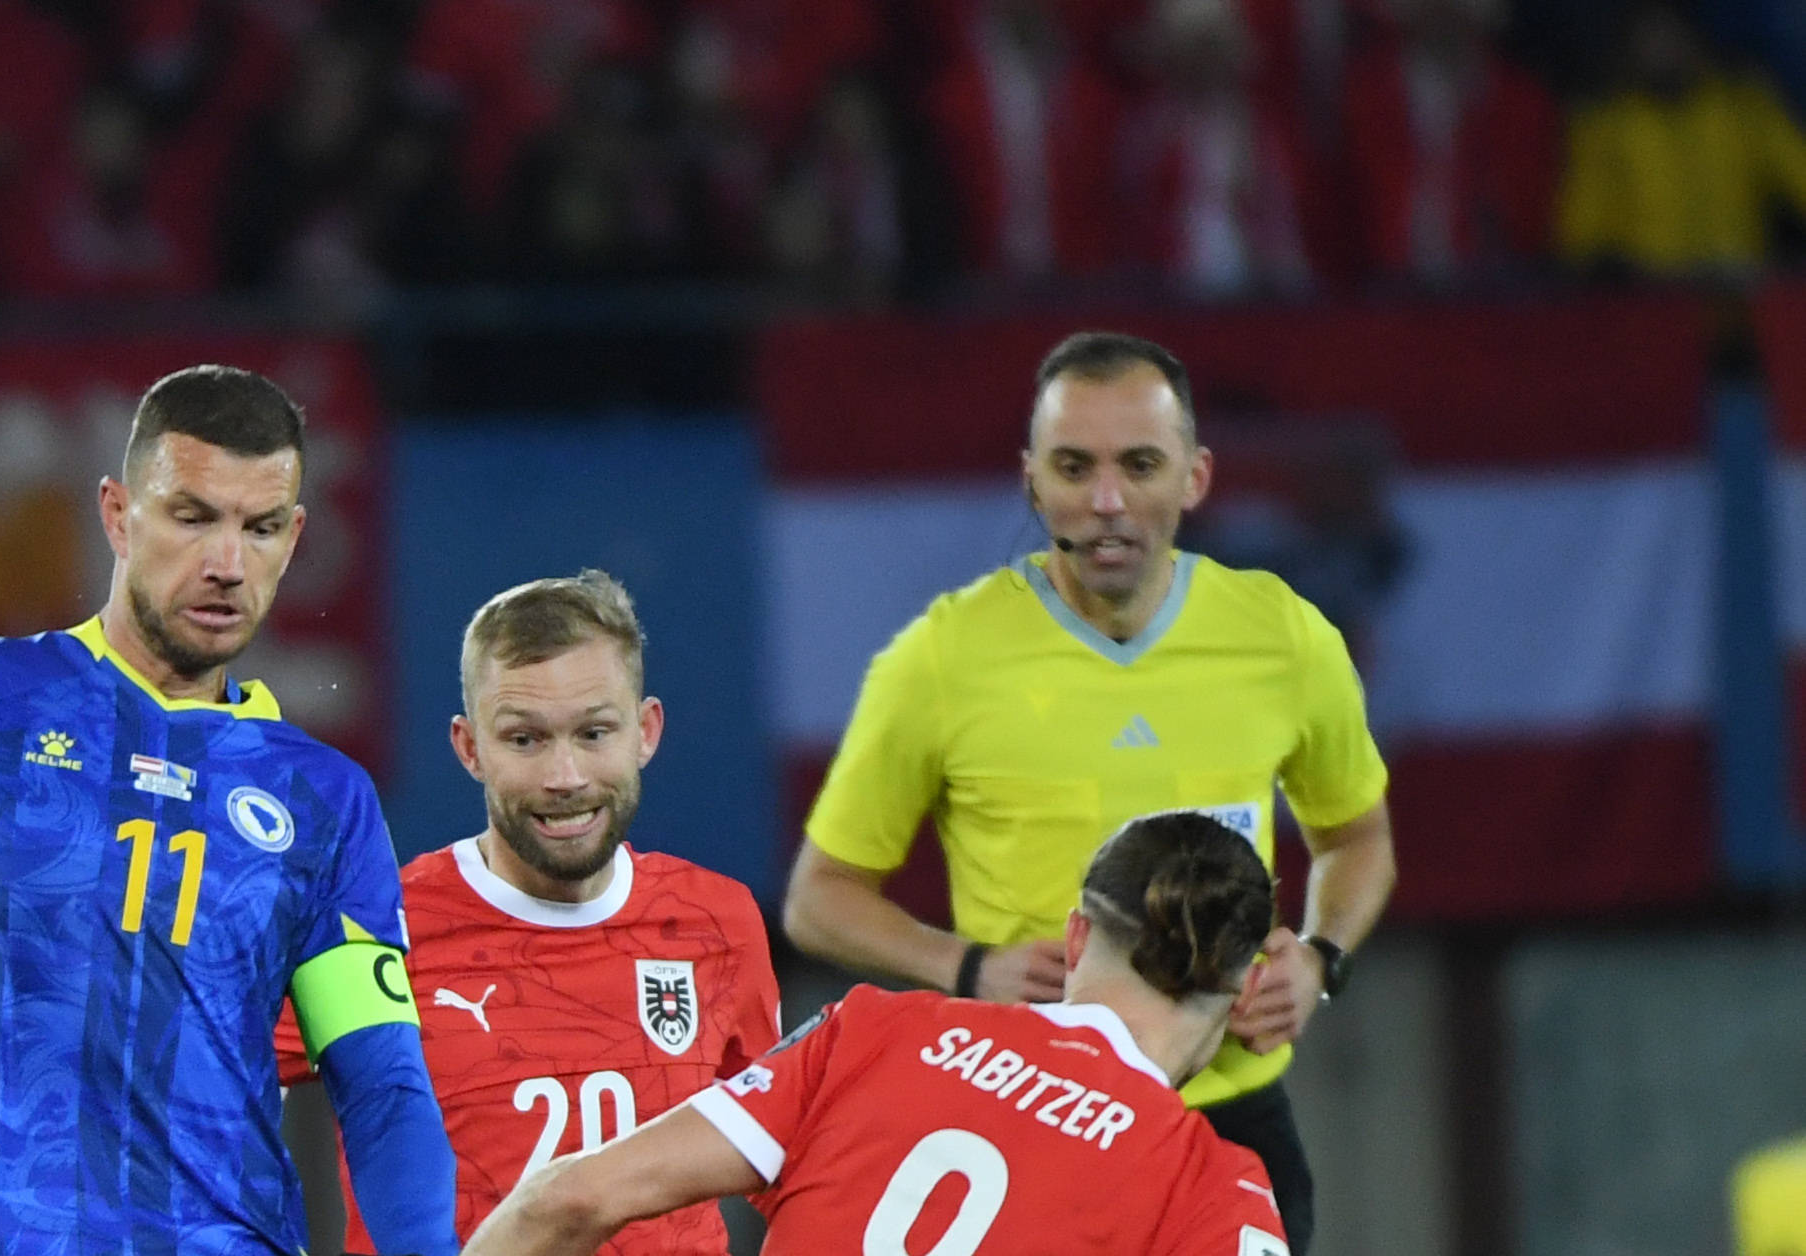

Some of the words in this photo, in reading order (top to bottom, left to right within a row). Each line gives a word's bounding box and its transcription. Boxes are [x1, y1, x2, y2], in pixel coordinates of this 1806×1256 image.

[25, 751, 83, 771] KELME
[116, 819, 206, 946] 11
[373, 952, 410, 1004] C
[513, 1070, 636, 1180] 20
[920, 1027, 1136, 1150] SABITZER
